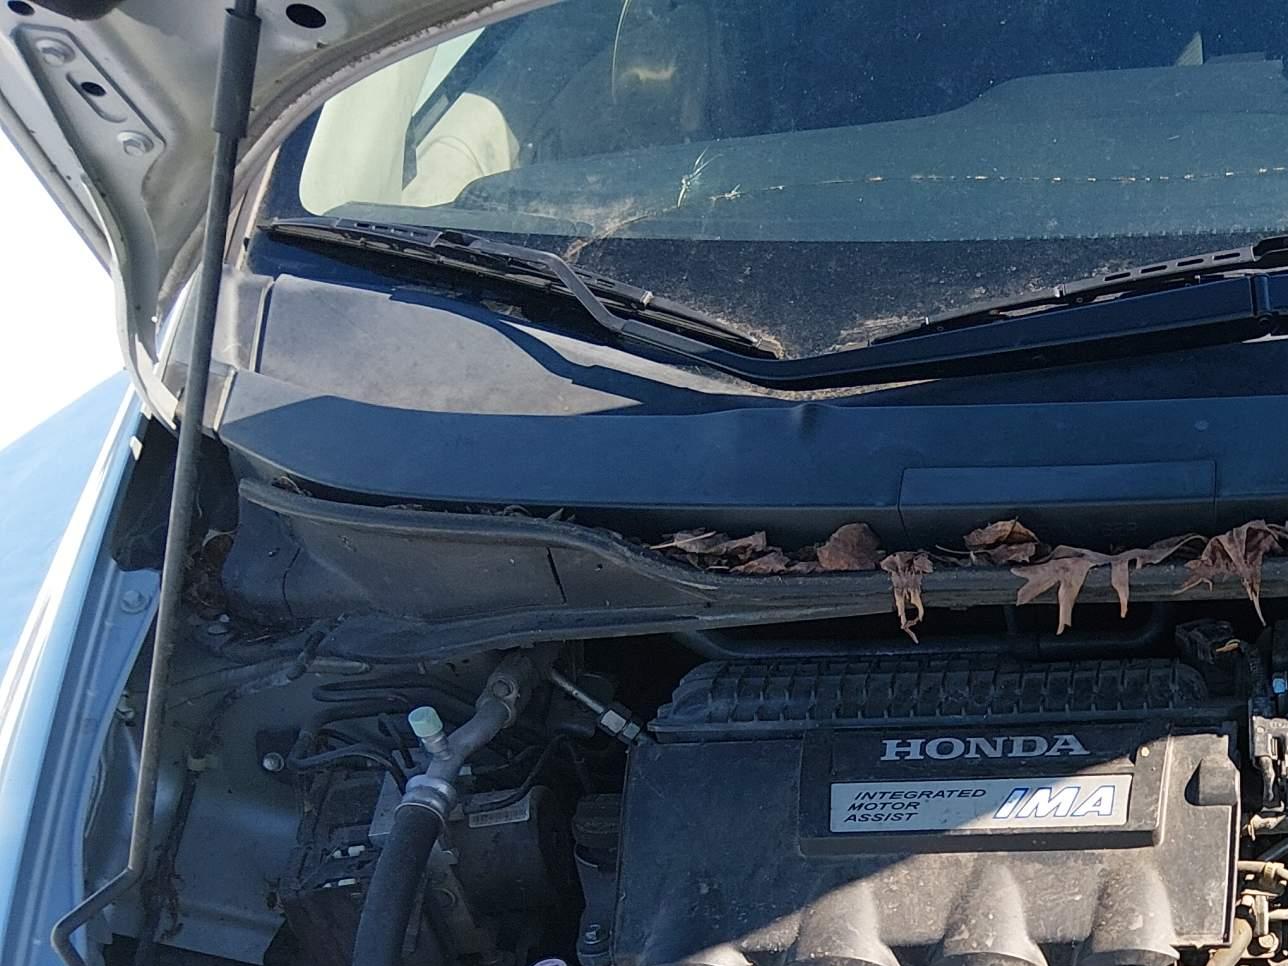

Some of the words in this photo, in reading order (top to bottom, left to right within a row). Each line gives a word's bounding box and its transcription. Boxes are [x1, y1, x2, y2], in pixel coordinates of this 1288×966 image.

[880, 734, 1091, 761] HONDA
[854, 788, 987, 801] INTEGRATED
[847, 801, 921, 812] MOTOR
[992, 785, 1116, 820] IMA
[844, 812, 919, 823] ASSIST
